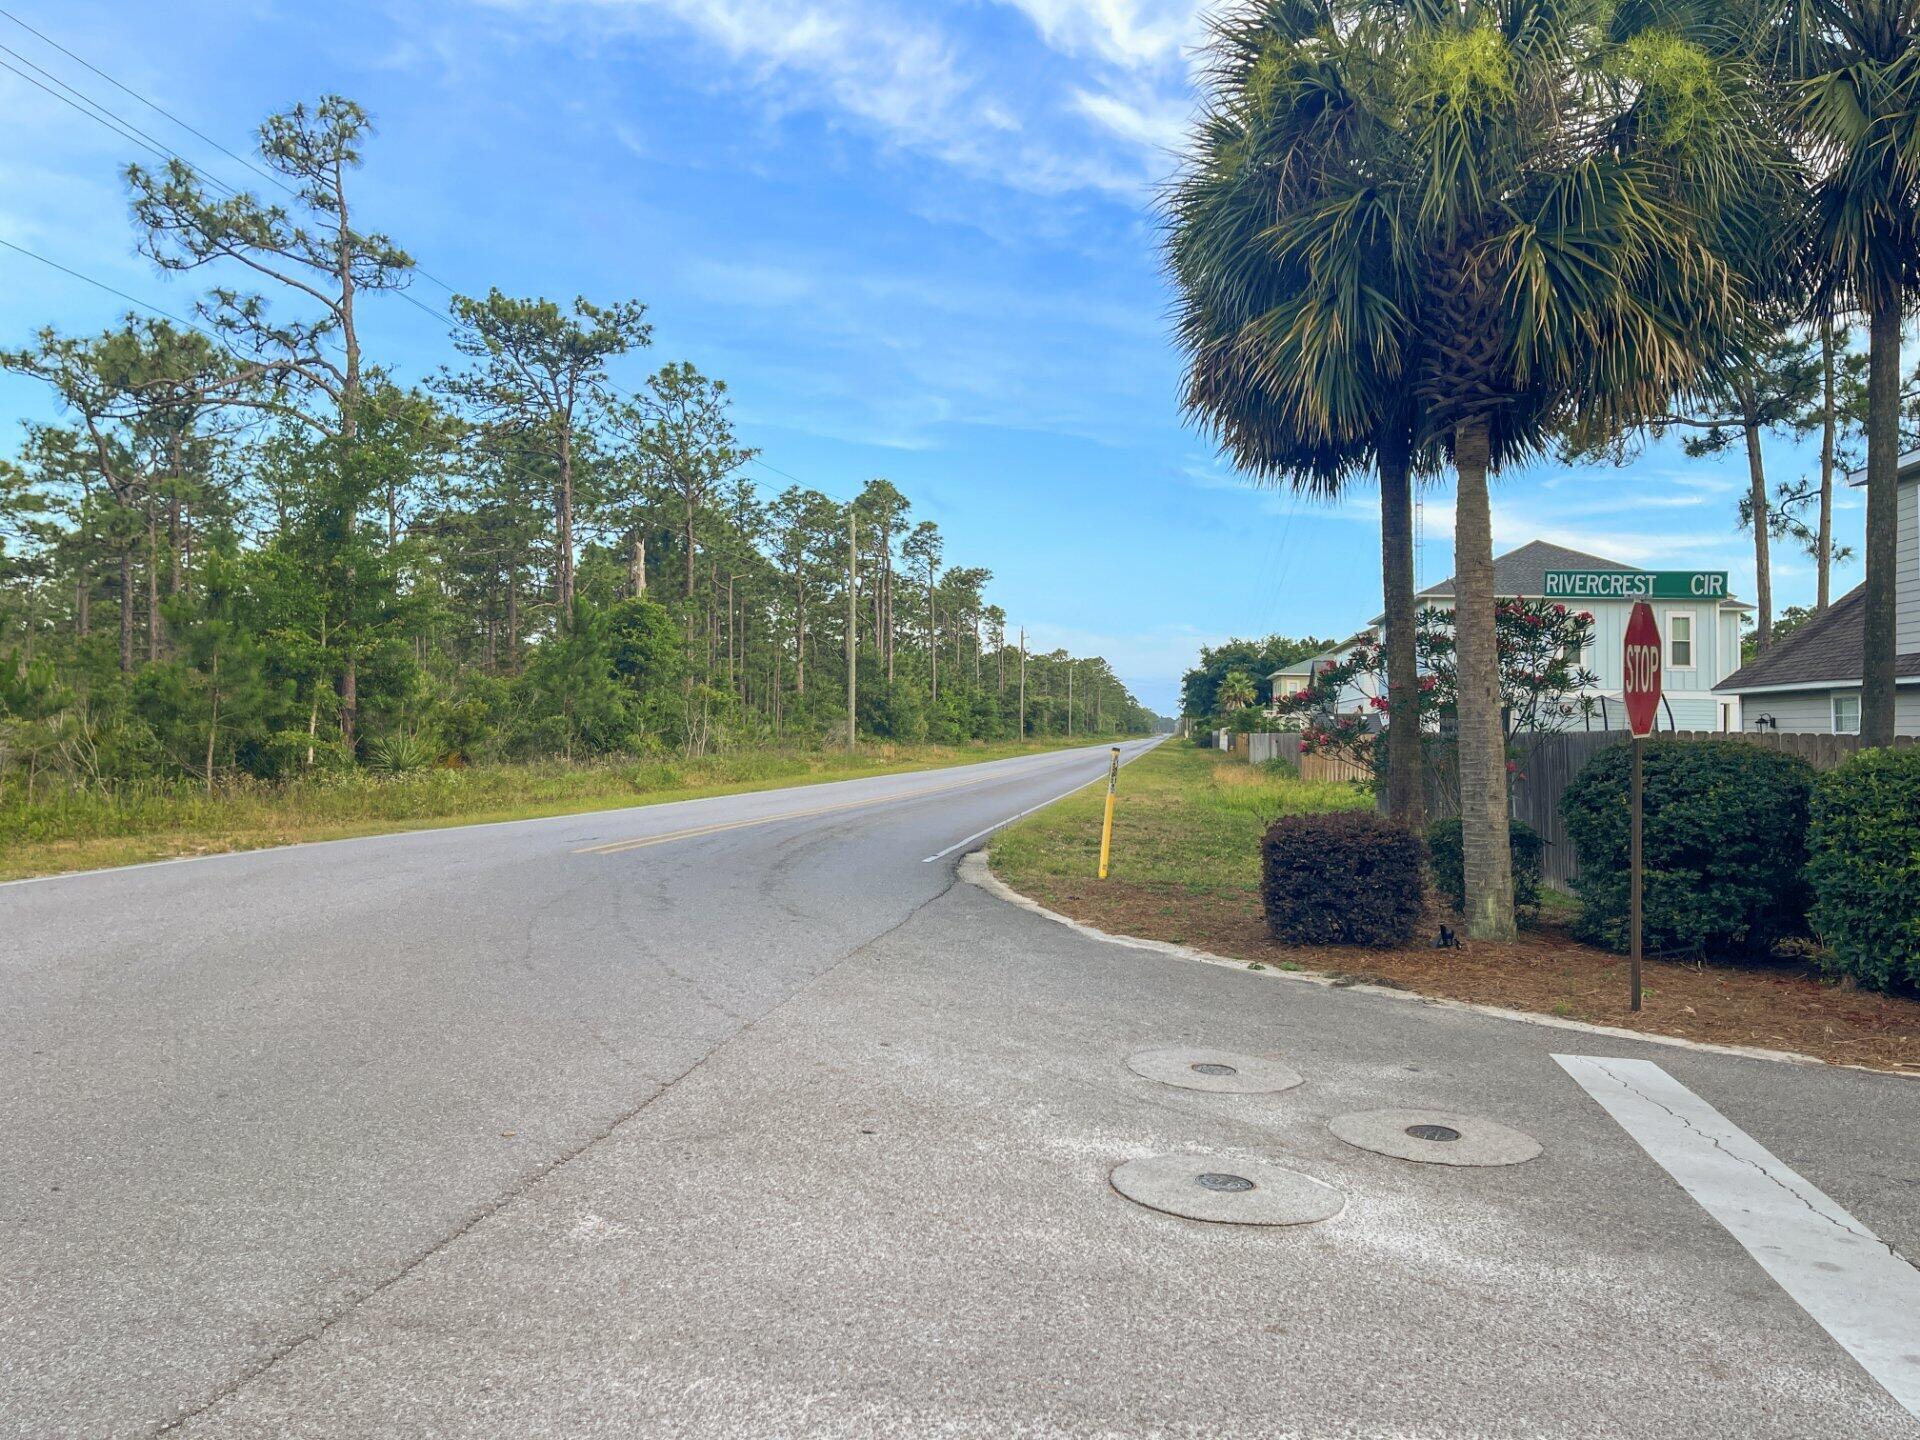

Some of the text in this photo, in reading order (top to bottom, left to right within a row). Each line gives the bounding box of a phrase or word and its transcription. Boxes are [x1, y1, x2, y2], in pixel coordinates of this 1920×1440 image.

[1546, 573, 1723, 595] RIVERCREST CIR
[1626, 645, 1659, 692] STOP
